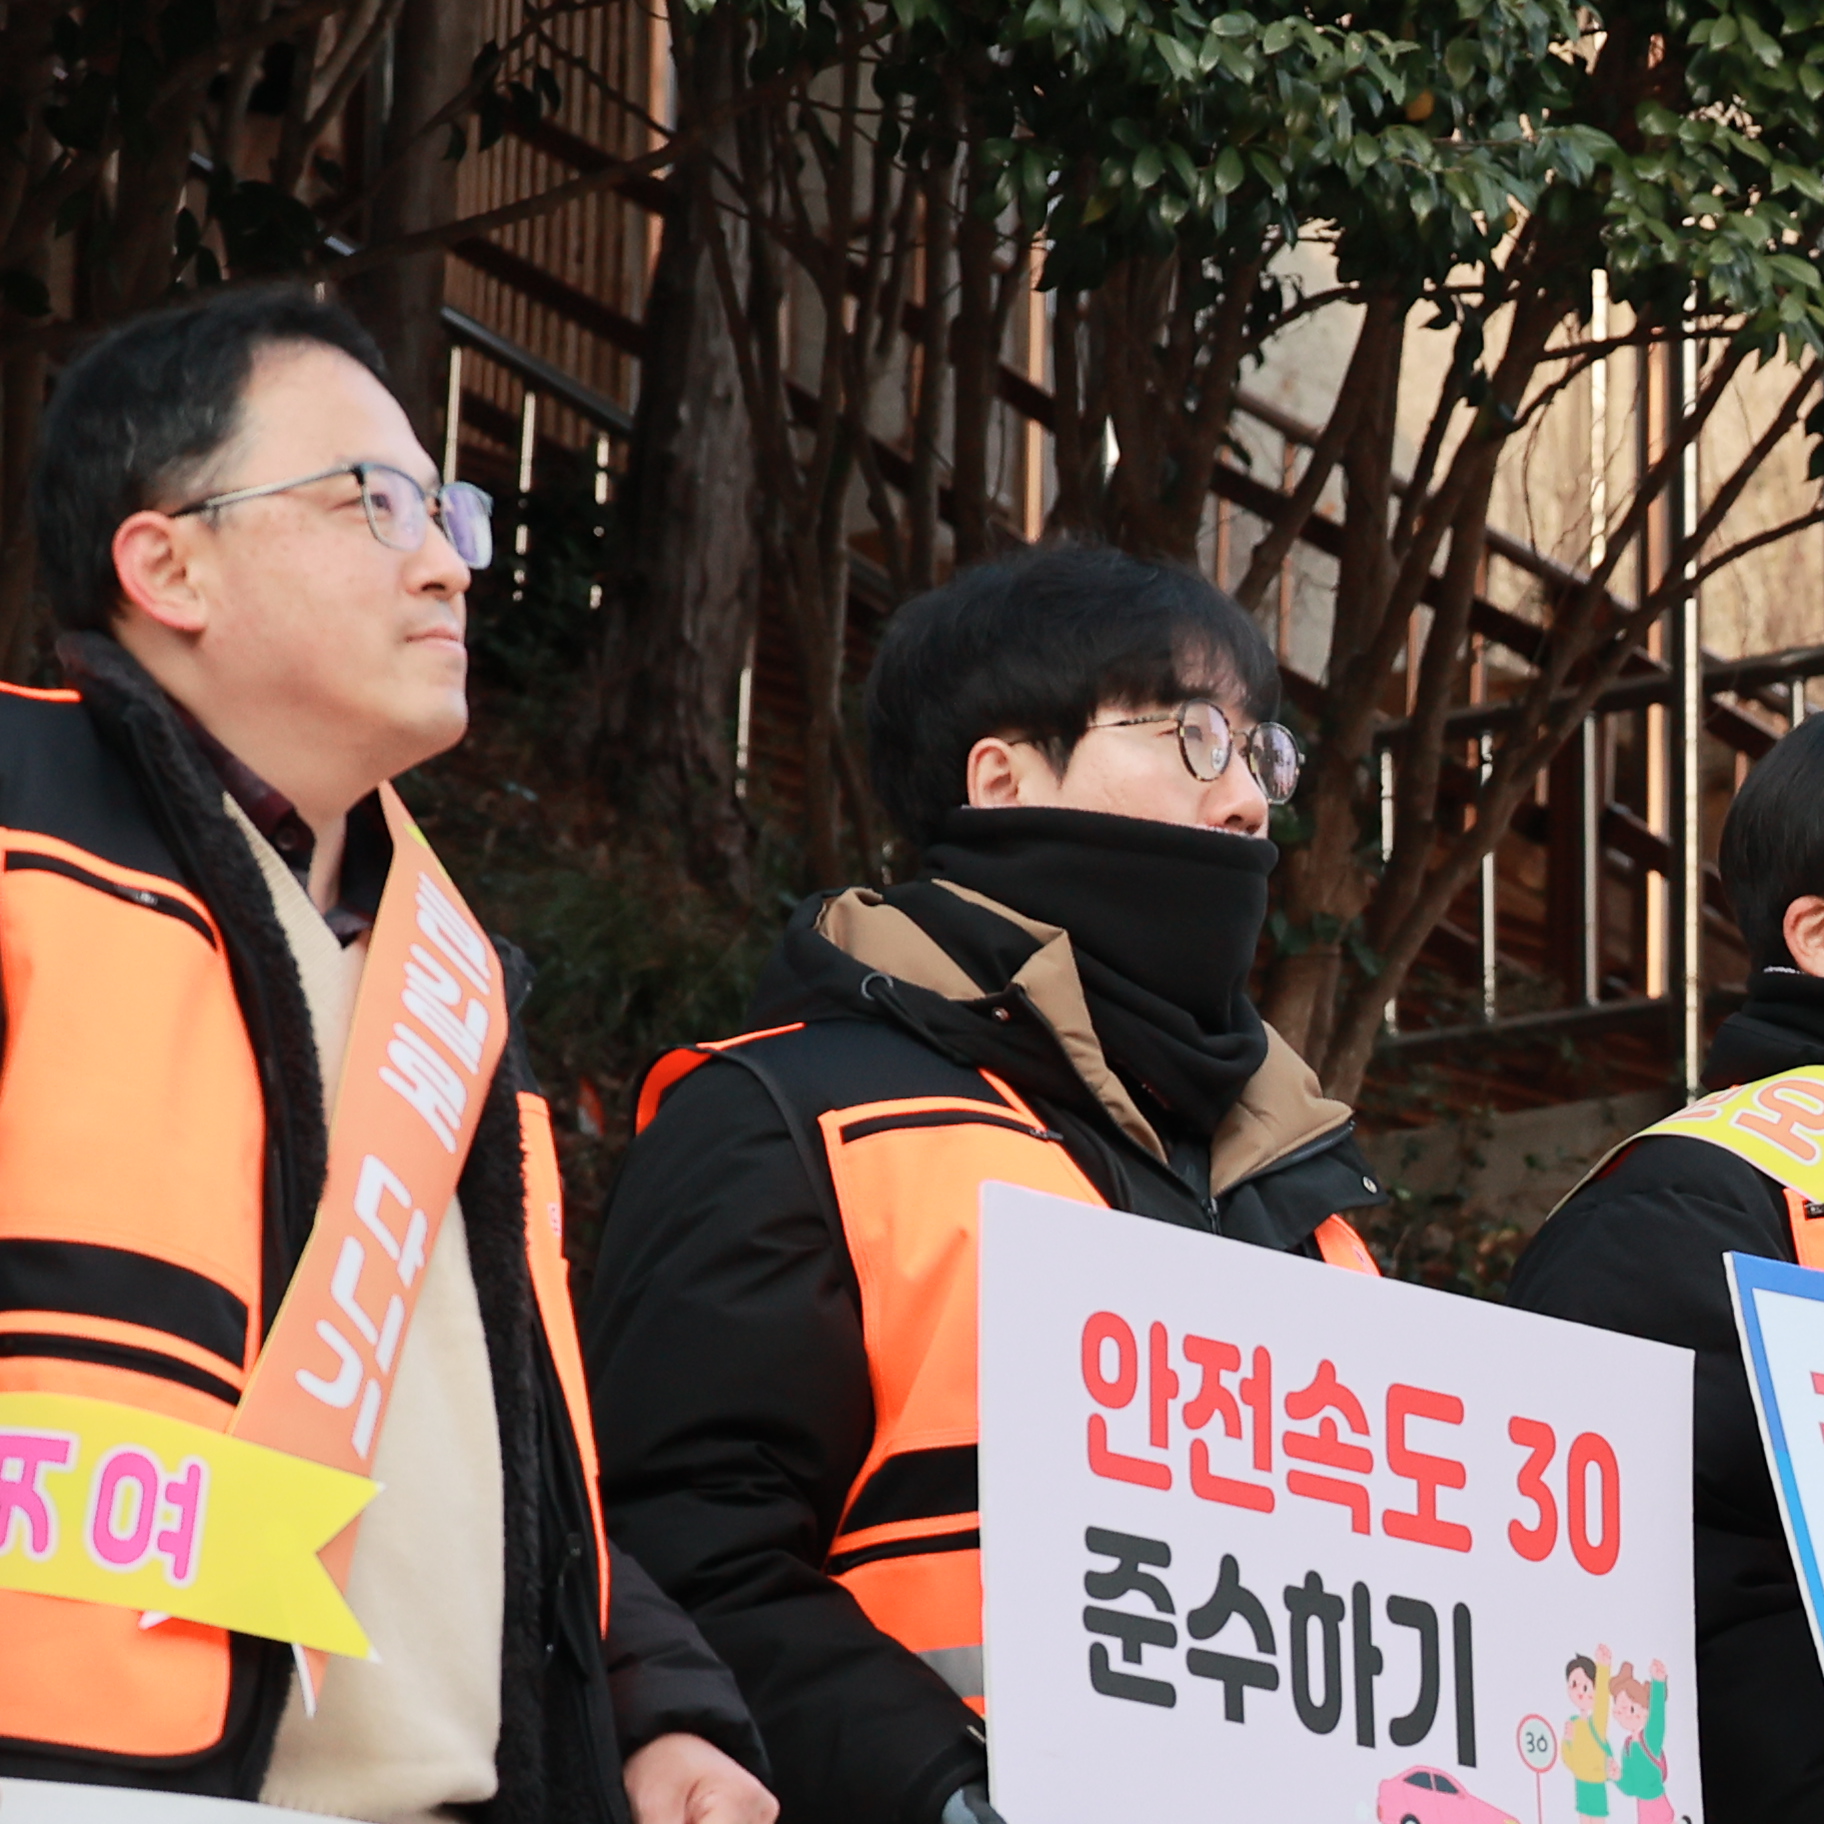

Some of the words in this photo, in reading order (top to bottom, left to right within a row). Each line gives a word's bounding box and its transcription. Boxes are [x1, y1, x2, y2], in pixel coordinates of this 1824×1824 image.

[1080, 1310, 1473, 1554] 안전속도
[1507, 1415, 1621, 1576] 30
[1082, 1525, 1478, 1768] 준수하기
[1525, 1733, 1549, 1754] 30
